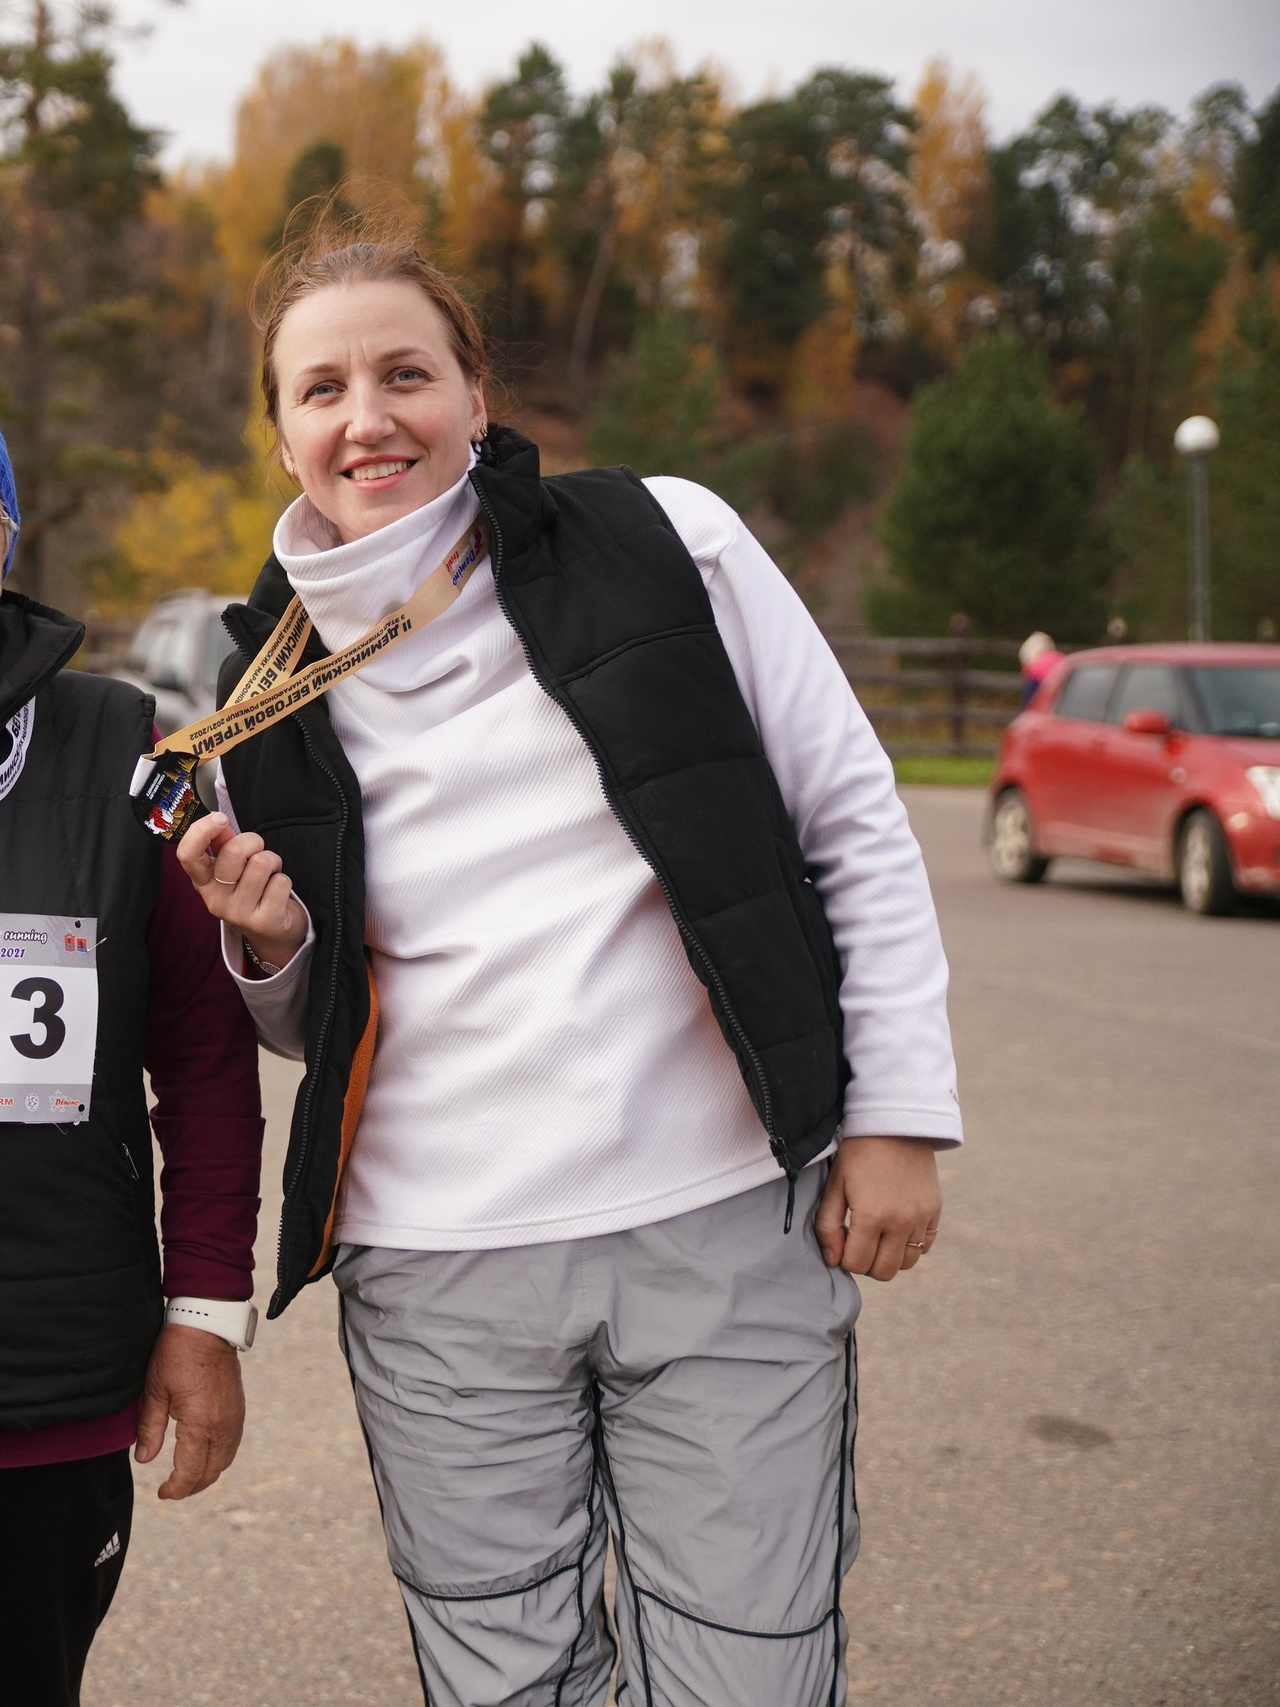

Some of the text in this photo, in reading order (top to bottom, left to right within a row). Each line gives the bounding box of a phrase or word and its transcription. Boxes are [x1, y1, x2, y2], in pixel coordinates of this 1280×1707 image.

[383, 616, 401, 631] ЭТАП
[259, 631, 286, 668] ДЕМИНСКИХ
[272, 609, 310, 672] ЕМИНСКИЙ
[343, 628, 385, 659] СУПЕРКУБКА
[311, 623, 401, 691] ДЕМИНСКИЙ
[243, 683, 311, 731] БЕГОВОЙ
[259, 679, 303, 708] МАРАФОНОВ
[224, 703, 260, 722] POWERUP
[188, 718, 226, 741] 2021/2022
[191, 721, 244, 757] ТРЕЙЛ
[4, 929, 48, 944] running
[0, 947, 25, 958] 2021
